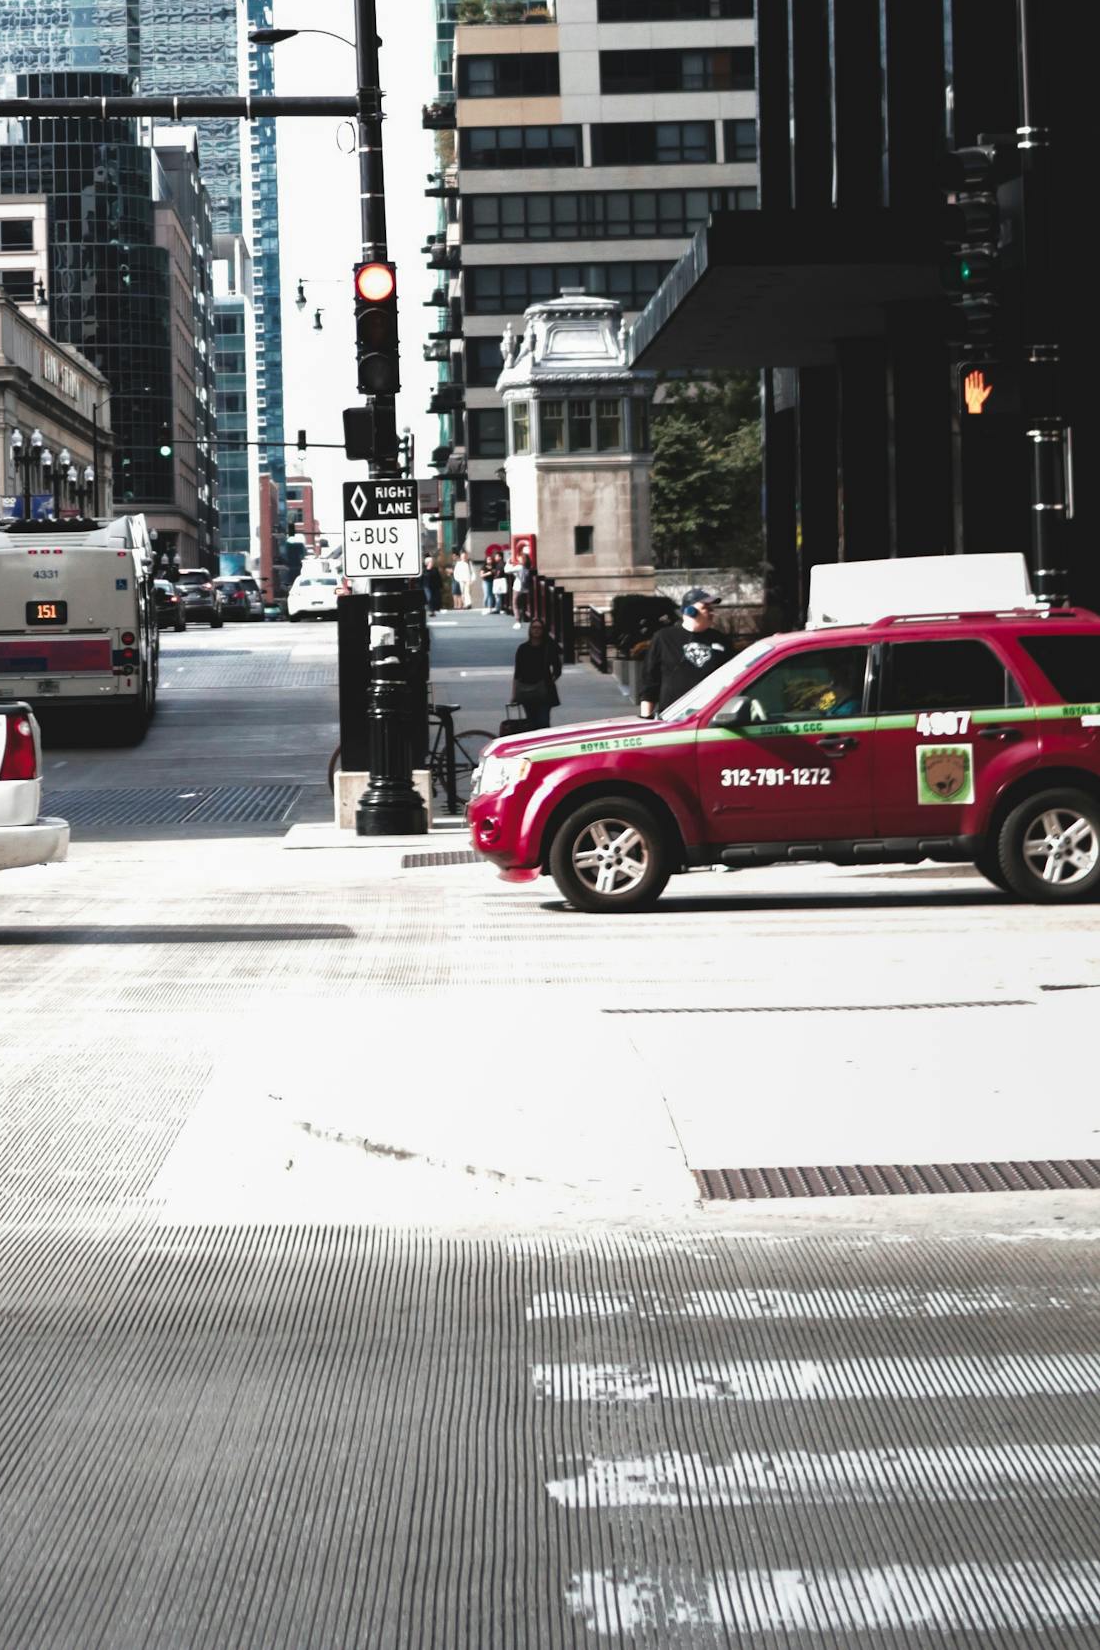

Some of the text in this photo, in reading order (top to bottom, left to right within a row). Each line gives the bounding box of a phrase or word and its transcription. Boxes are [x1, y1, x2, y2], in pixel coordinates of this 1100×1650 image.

[375, 486, 413, 499] RIGHT
[378, 502, 412, 515] LANE
[364, 526, 399, 545] BUS
[359, 551, 405, 570] ONLY
[32, 569, 59, 579] 4331
[36, 604, 57, 619] 151
[580, 740, 611, 752] ROYAL
[720, 768, 831, 787] 312-791-1272
